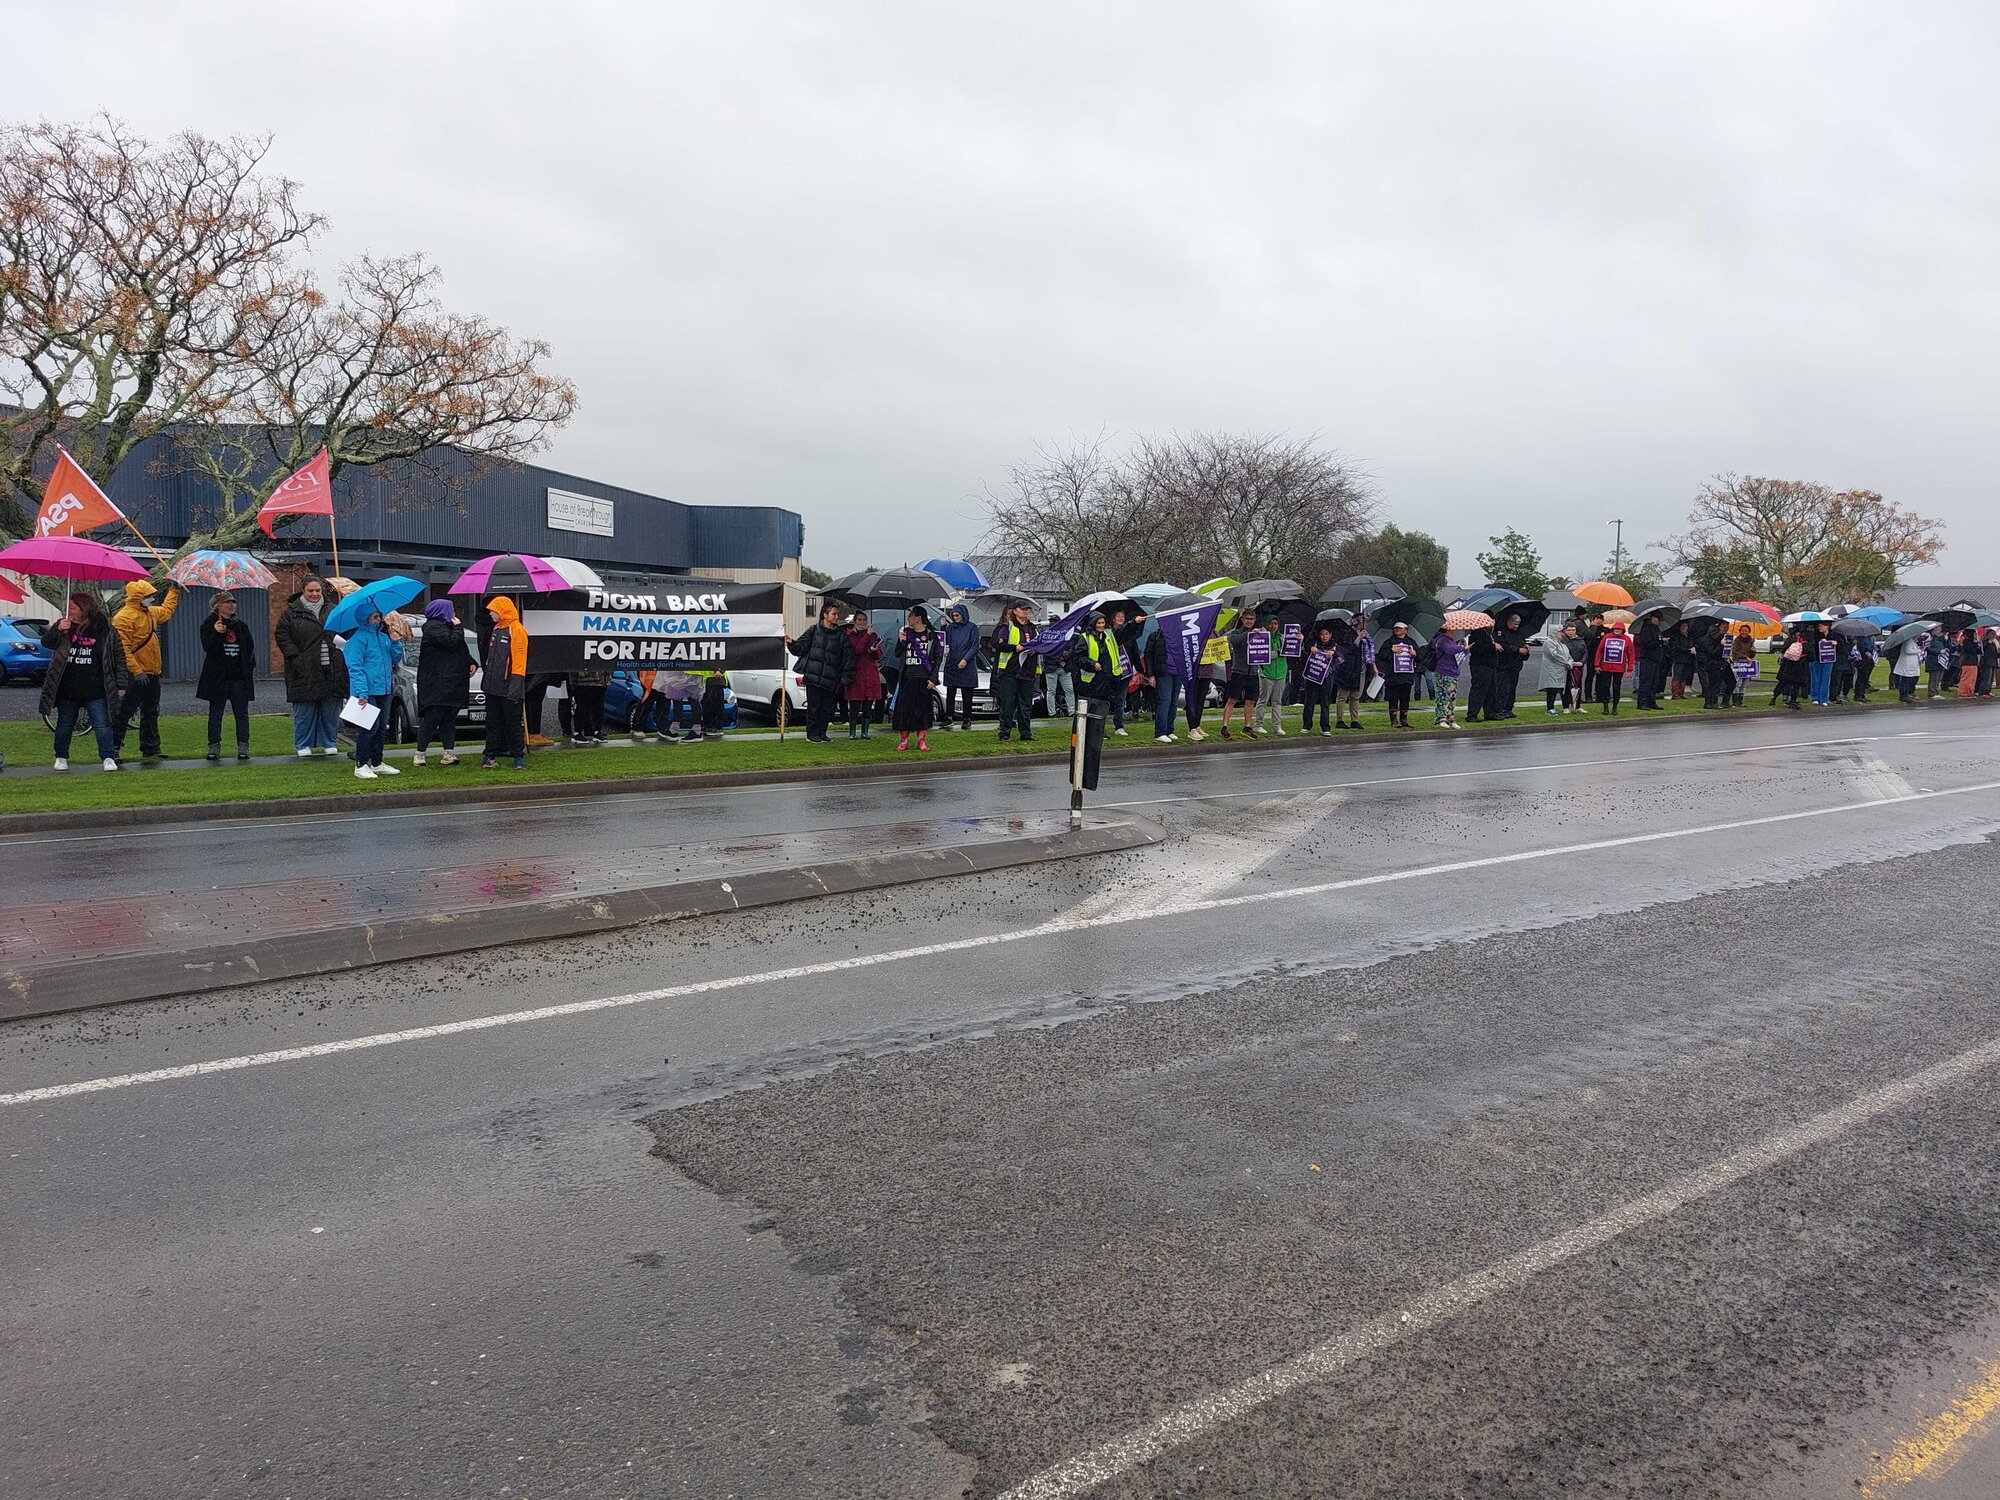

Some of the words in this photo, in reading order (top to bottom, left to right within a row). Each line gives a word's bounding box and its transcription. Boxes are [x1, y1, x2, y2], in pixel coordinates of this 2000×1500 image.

[550, 499, 569, 514] House
[570, 502, 577, 515] of
[588, 591, 656, 611] FIGHT
[666, 593, 728, 611] BACK
[583, 615, 691, 634] MARANGA
[694, 618, 730, 634] AKE
[79, 647, 92, 656] fair
[584, 640, 636, 660] FOR
[640, 641, 726, 661] HEALTH
[75, 657, 92, 665] care
